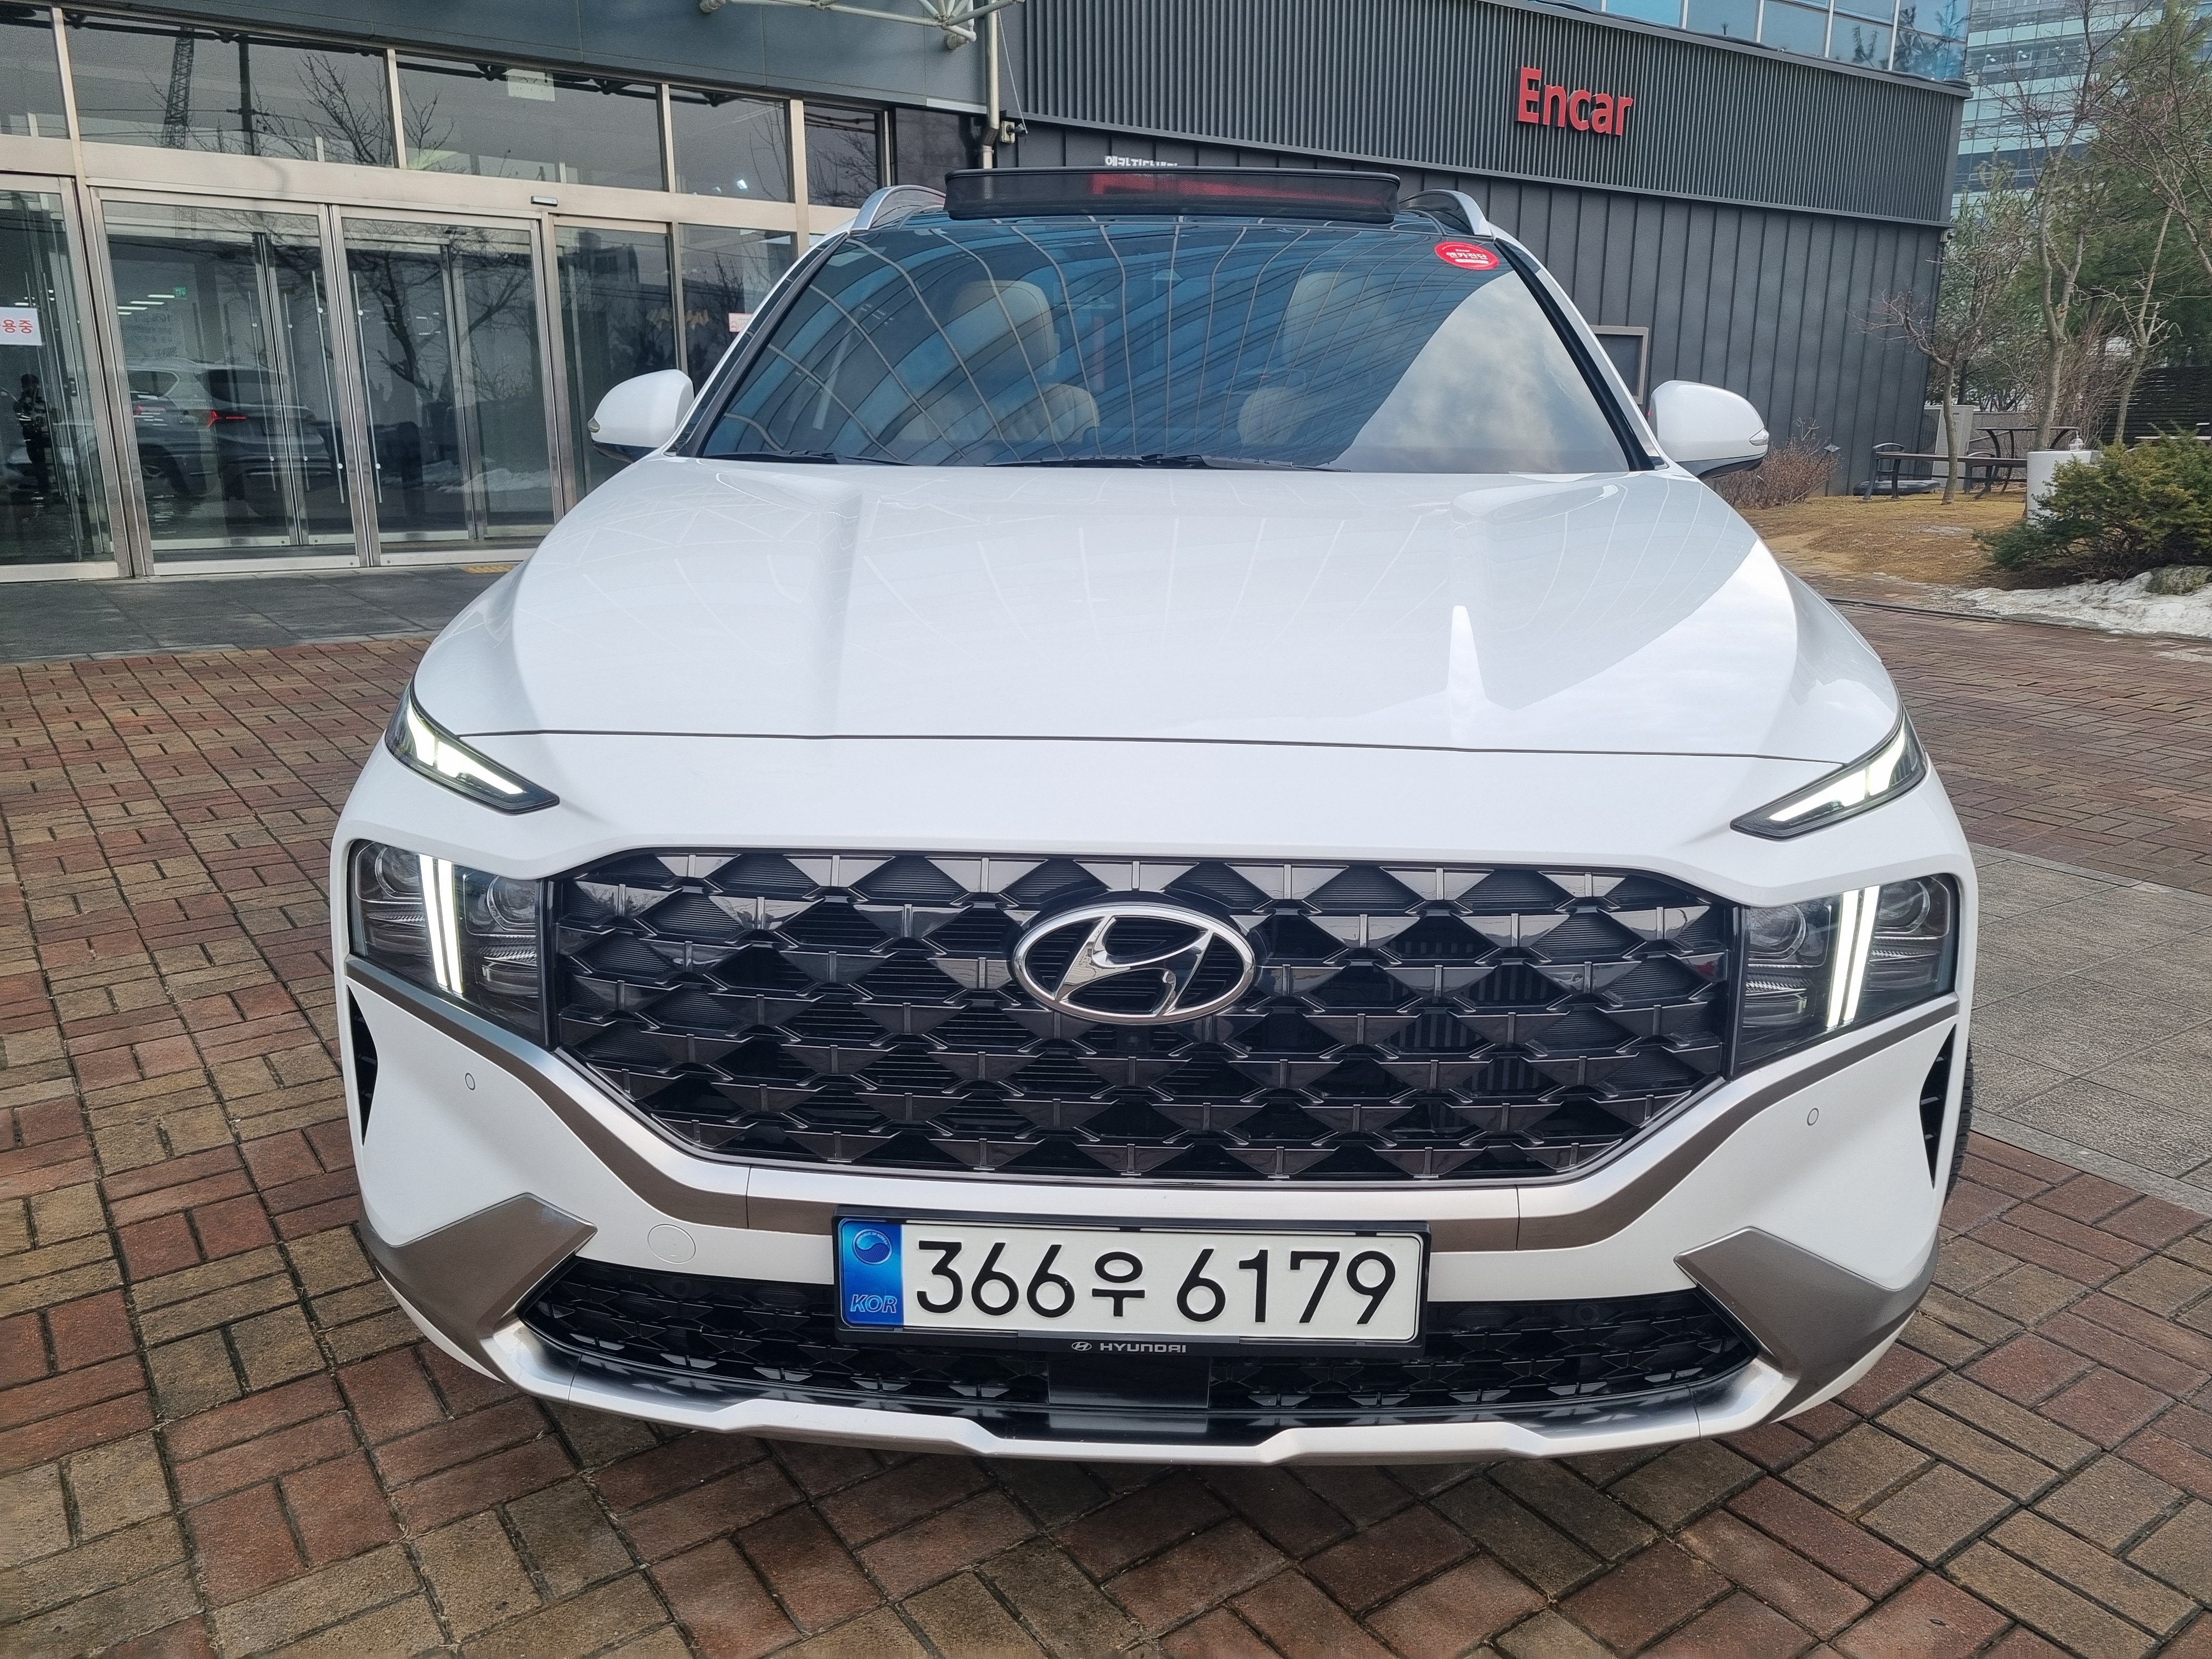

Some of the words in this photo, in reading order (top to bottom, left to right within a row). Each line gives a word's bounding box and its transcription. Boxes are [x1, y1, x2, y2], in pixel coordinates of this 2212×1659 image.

[1515, 66, 1634, 136] Encar
[1446, 252, 1488, 260] 엔카진단
[917, 1240, 1146, 1318] 366우
[1177, 1248, 1396, 1324] 6179
[850, 1294, 898, 1313] KOR
[1100, 1342, 1186, 1353] HYUNDAI
